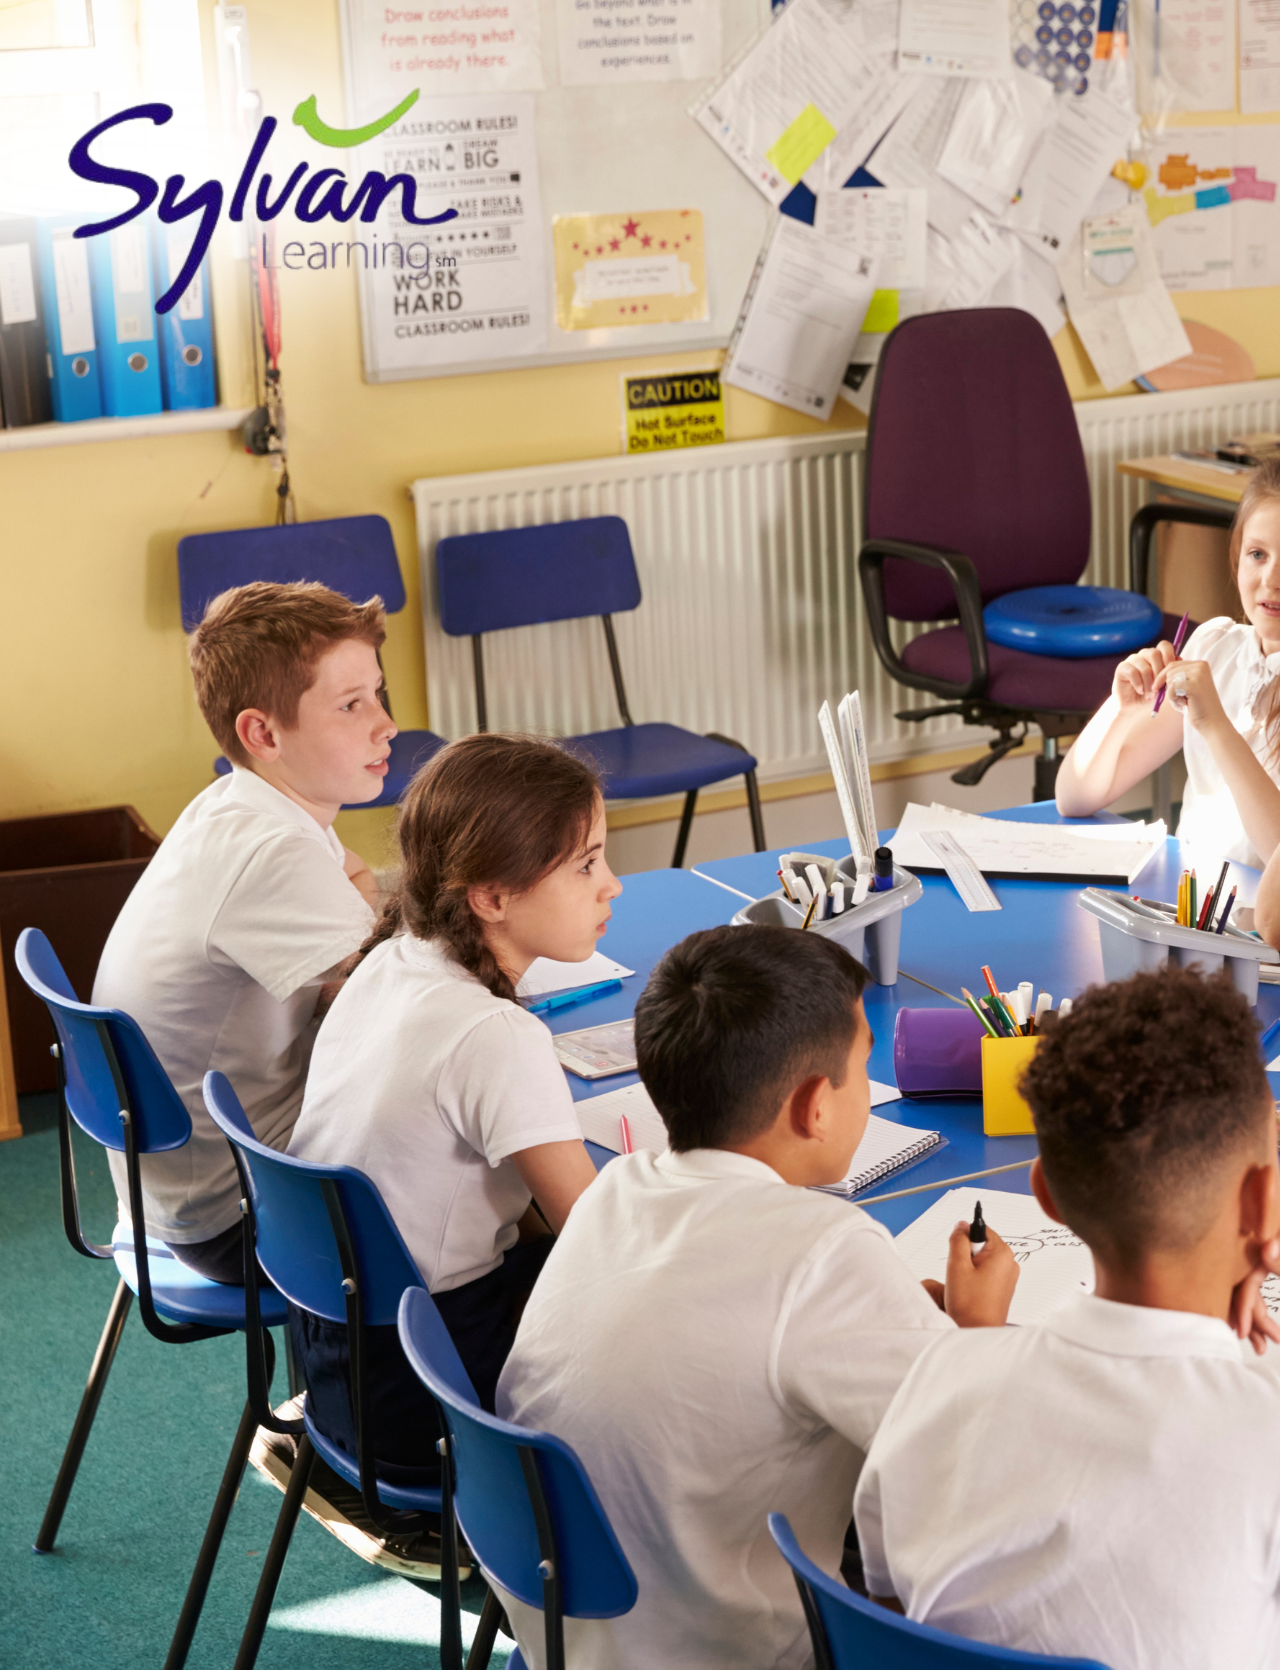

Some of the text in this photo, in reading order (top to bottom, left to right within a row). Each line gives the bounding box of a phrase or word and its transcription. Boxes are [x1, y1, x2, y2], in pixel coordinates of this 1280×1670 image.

[384, 5, 509, 24] Draw conclusions
[593, 16, 612, 28] the
[647, 13, 677, 27] Draw
[381, 29, 515, 49] from reading what
[577, 32, 694, 50] conclusions based on
[389, 53, 510, 72] is already there.
[382, 115, 518, 138] CLASSROOM RULES!
[384, 157, 441, 176] LEARN
[464, 150, 499, 169] BIG
[394, 270, 461, 292] WORK
[394, 290, 463, 316] HARD
[394, 313, 530, 339] CLASSROOM RULES!
[629, 378, 718, 405] CAUTION
[636, 413, 716, 432] Hot Surface
[630, 428, 724, 450] Do Not Touch
